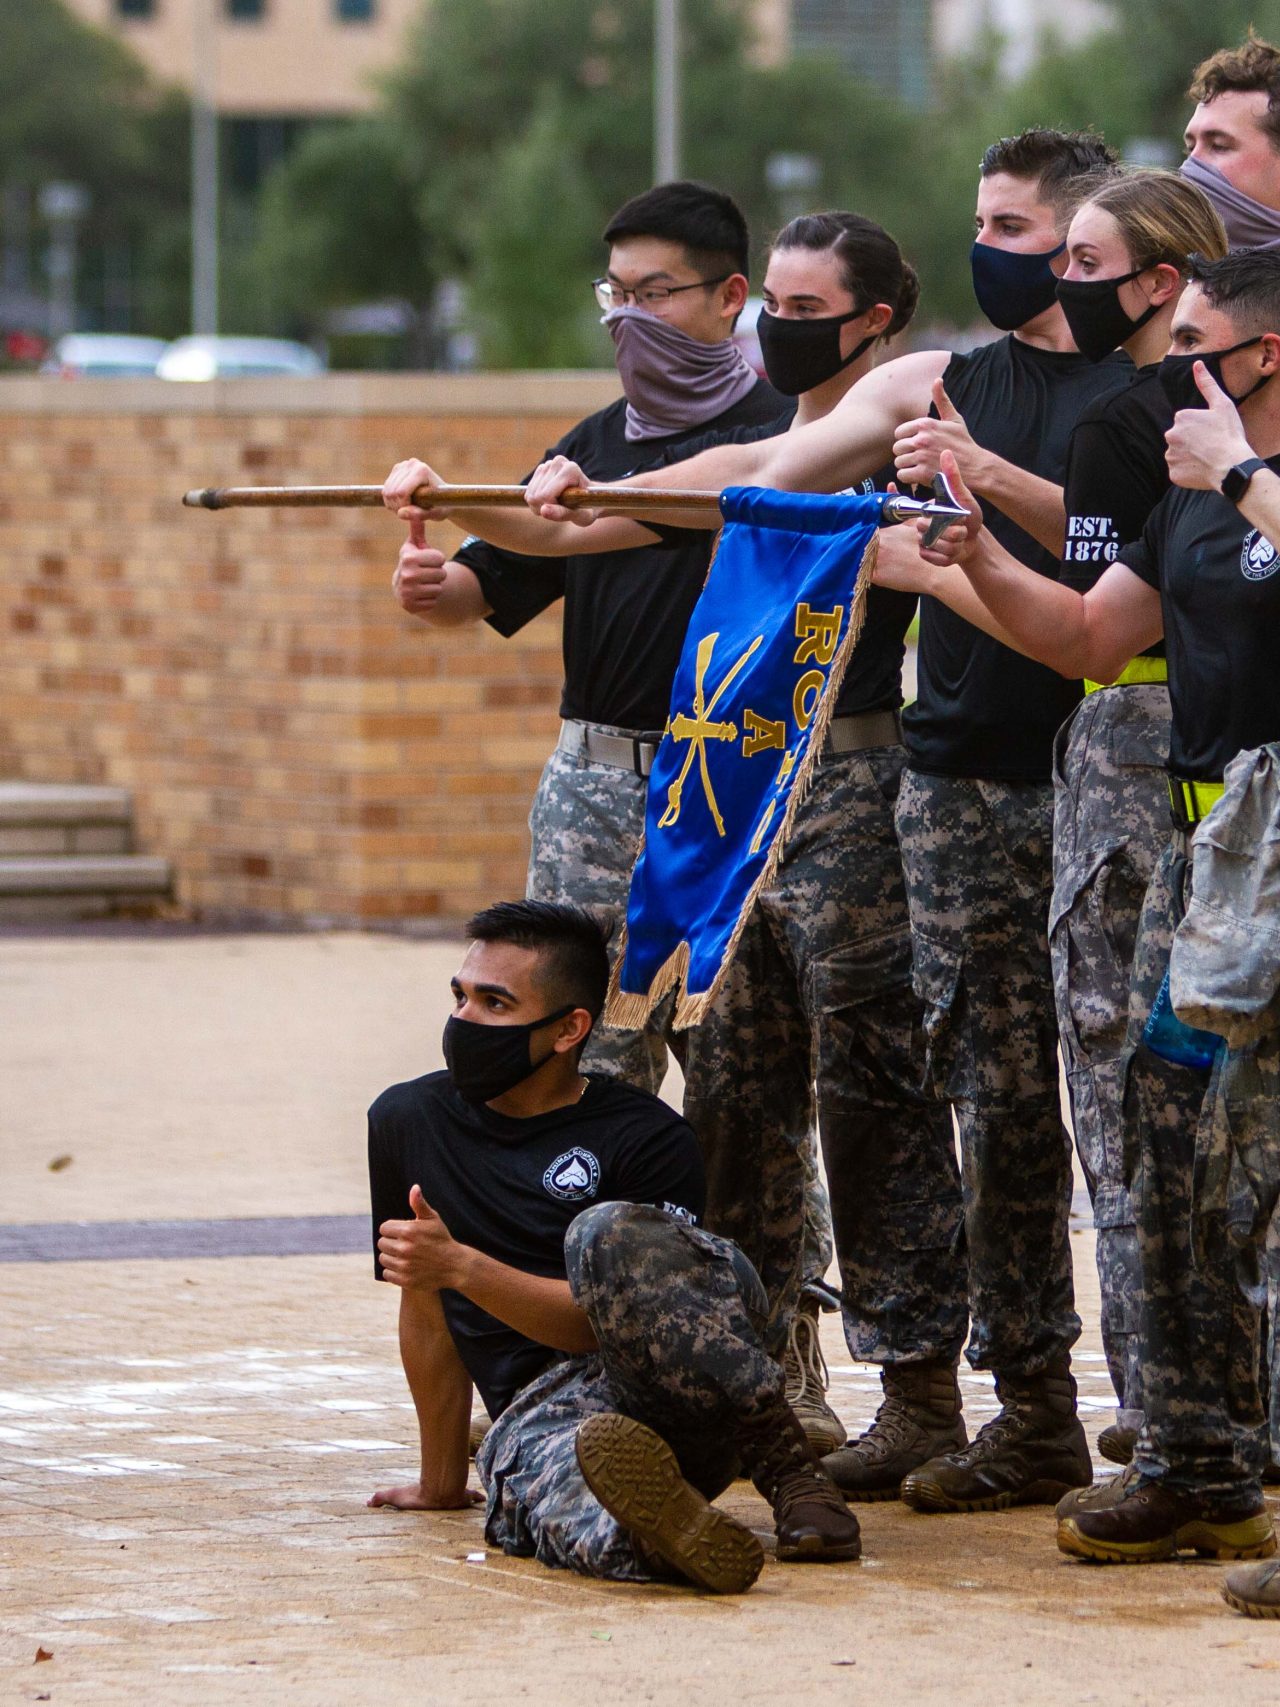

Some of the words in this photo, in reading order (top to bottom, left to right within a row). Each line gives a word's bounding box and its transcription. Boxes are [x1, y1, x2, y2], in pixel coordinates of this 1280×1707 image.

[1068, 516, 1119, 538] EST.
[1065, 541, 1119, 561] 1876
[743, 709, 786, 758] A
[572, 1148, 597, 1170] COMPANY
